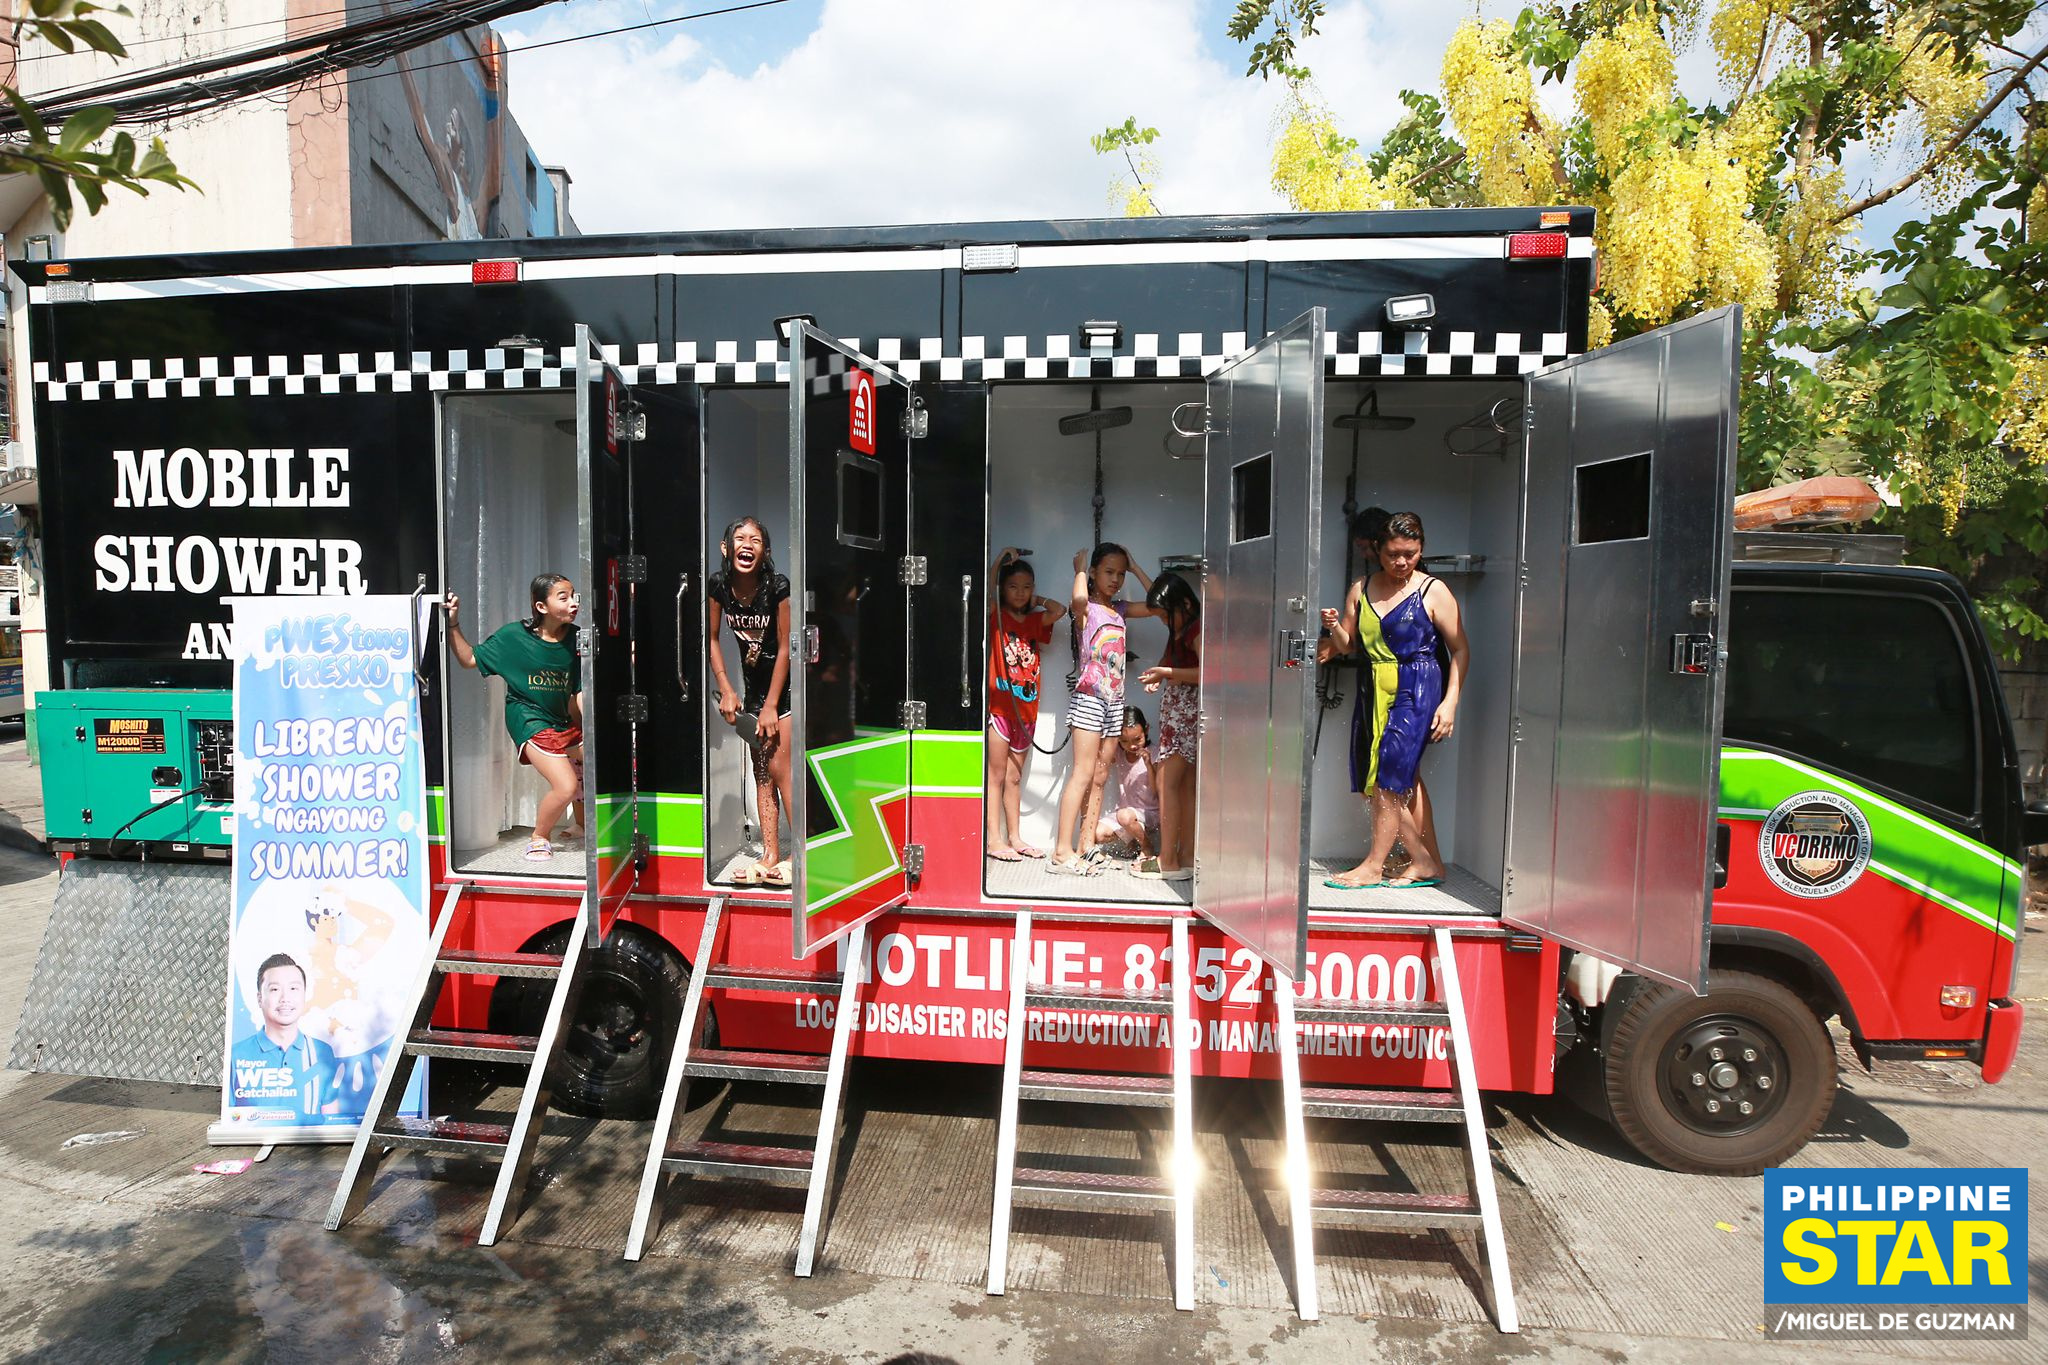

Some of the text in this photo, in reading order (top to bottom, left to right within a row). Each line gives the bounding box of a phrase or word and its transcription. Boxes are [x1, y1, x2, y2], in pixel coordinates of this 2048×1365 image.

[113, 447, 350, 508] MOBILE
[94, 535, 368, 596] SHOWER
[725, 613, 770, 629] NICORN
[181, 622, 234, 660] AN
[281, 654, 389, 688] PRESKO
[109, 719, 149, 734] MOSHITO
[254, 717, 406, 757] LIBRENG
[97, 737, 140, 746] M12000D
[261, 762, 401, 802] SHOWER
[1777, 795, 1819, 817] REDUCTION
[1821, 795, 1838, 804] AND
[275, 806, 387, 834] NGAYONG
[1767, 818, 1779, 835] RISK
[1838, 801, 1868, 844] MANAGEMENT
[250, 839, 408, 880] SUMMER!
[1763, 836, 1776, 871] DISASTER
[1774, 833, 1859, 860] VCDRRMO
[1781, 878, 1847, 895] VALENZUELA CITY
[866, 1001, 966, 1038] DISASTER
[972, 1007, 1010, 1040] RIS
[1028, 1010, 1150, 1047] REDUCTION
[1156, 1017, 1203, 1050] AD
[1371, 1026, 1450, 1061] COUNC
[235, 1067, 294, 1088] WES
[236, 1059, 268, 1070] Mayor
[235, 1087, 298, 1098] Gatchalian
